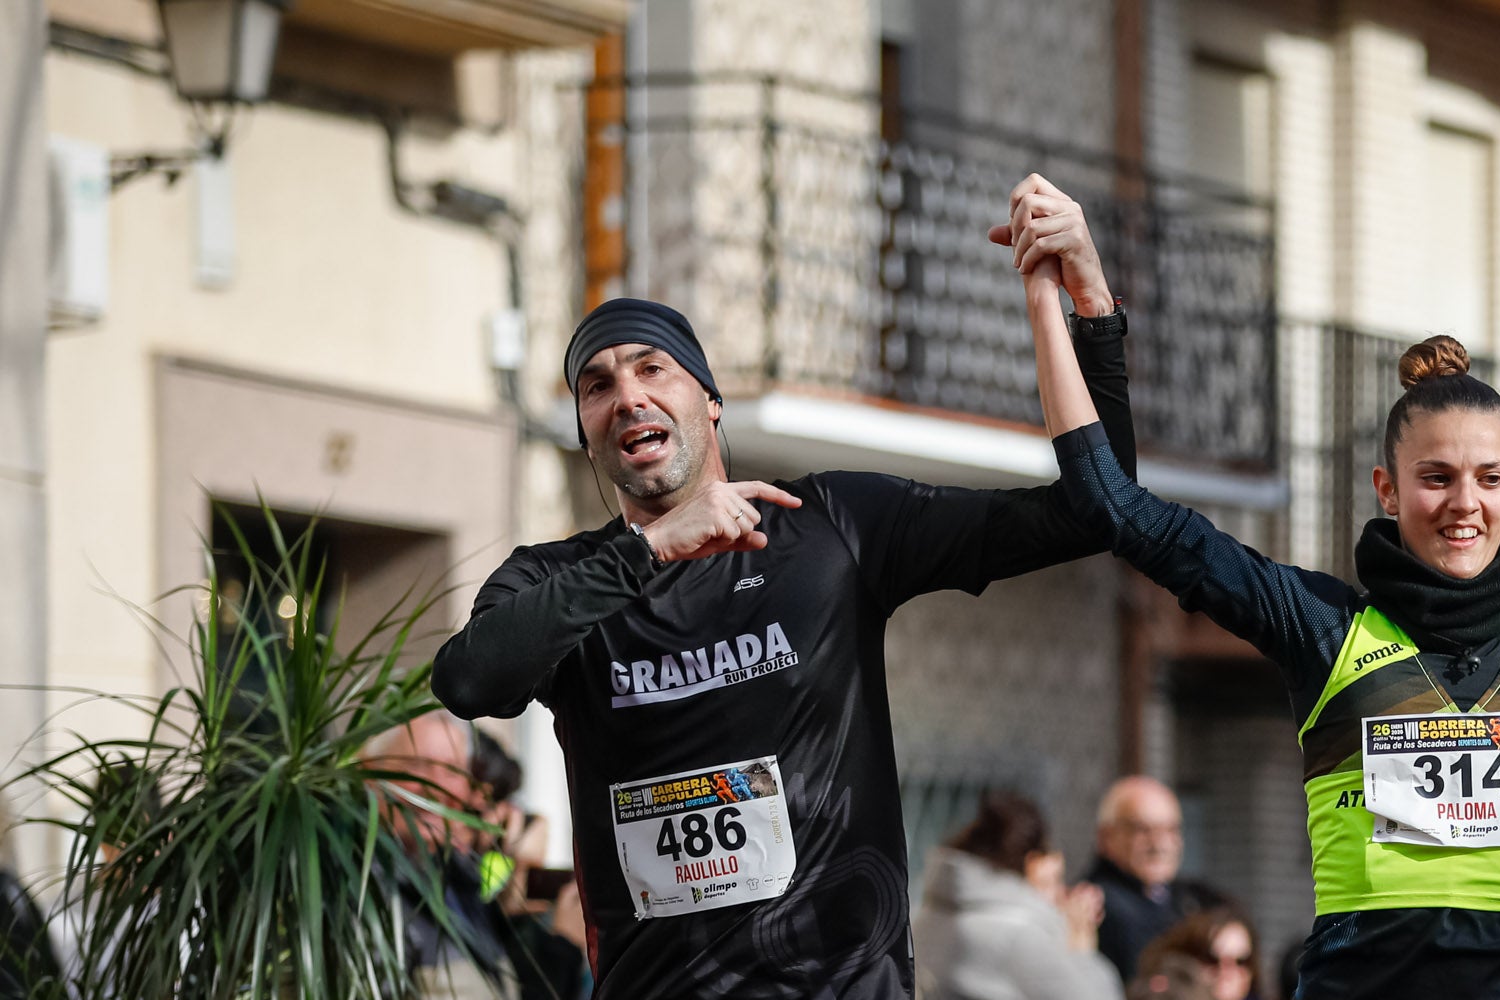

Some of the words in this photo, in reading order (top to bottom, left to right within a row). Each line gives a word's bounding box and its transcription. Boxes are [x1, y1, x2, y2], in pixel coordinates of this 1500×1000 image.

[611, 622, 793, 695] GRANADA
[724, 669, 749, 685] RUN
[751, 653, 798, 680] PROJECT
[1373, 723, 1391, 736] 26
[1419, 719, 1487, 731] CARRERA
[1420, 729, 1487, 740] POPULAR
[1373, 741, 1391, 751] Ruta
[1392, 740, 1402, 750] de
[1403, 740, 1416, 749] los
[1417, 739, 1457, 749] Secaderos
[617, 792, 633, 806] 26
[652, 776, 711, 796] CARRERA
[653, 787, 712, 804] POPULAR
[620, 808, 635, 819] Ruta
[635, 807, 644, 817] de
[644, 806, 652, 815] los
[652, 801, 684, 814] Secaderos
[1437, 802, 1497, 821] PALOMA
[655, 806, 747, 863] 486
[1463, 824, 1499, 834] olimpo
[675, 855, 739, 884] RAULILLO
[703, 881, 738, 894] olimpo
